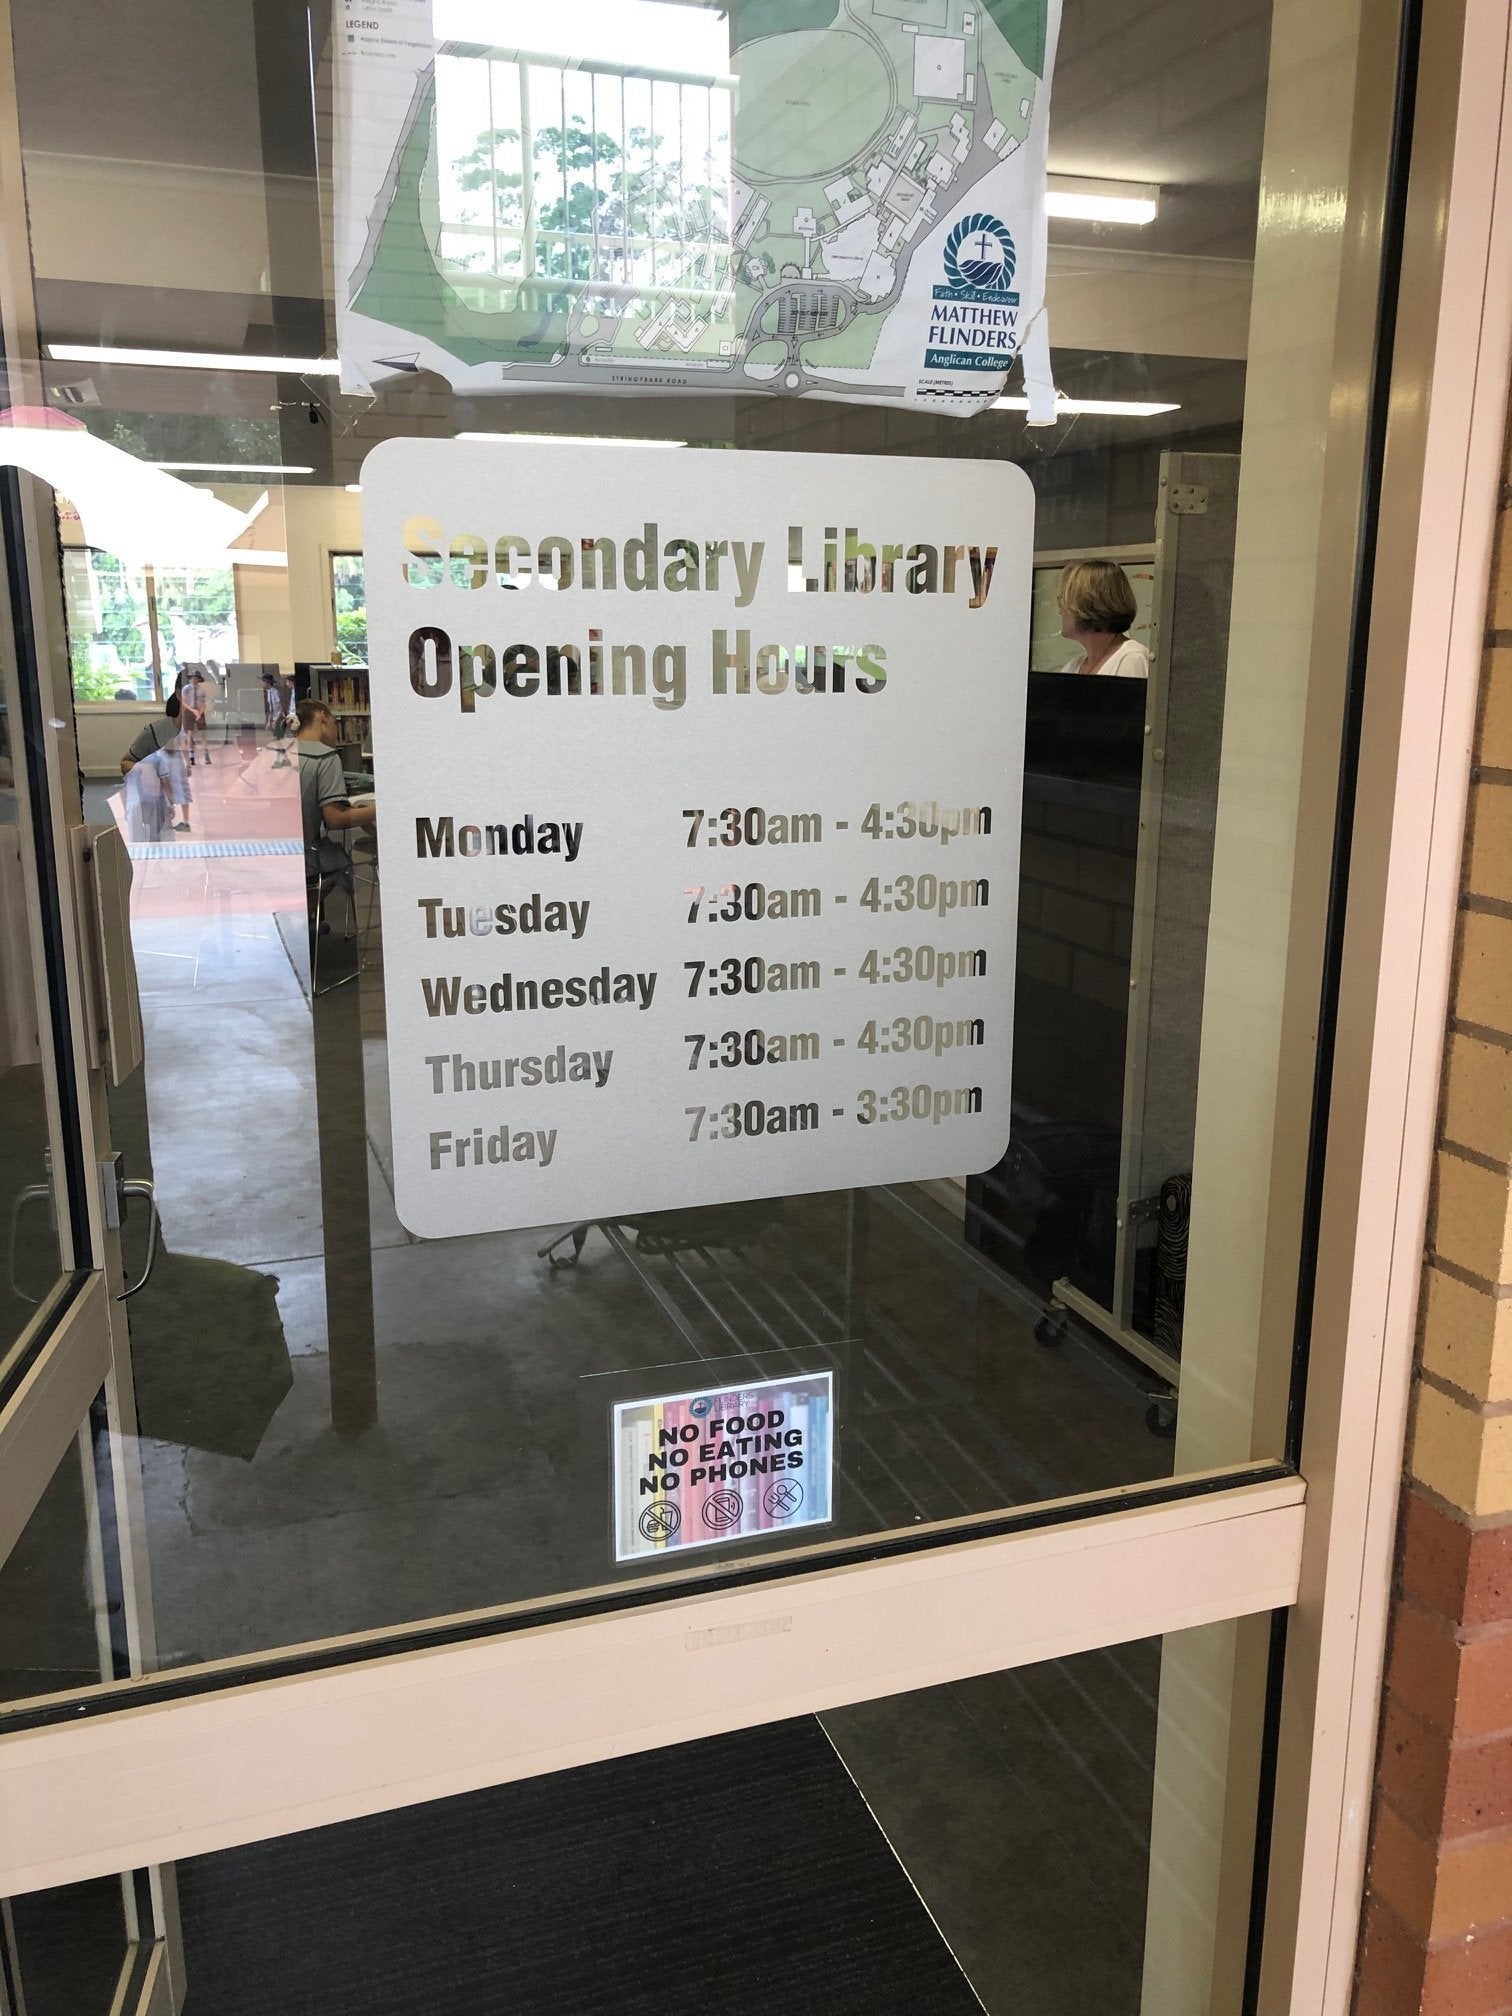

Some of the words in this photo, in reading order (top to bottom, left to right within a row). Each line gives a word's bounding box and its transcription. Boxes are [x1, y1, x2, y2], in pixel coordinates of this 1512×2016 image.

[345, 20, 379, 29] LEGEND
[931, 304, 1019, 327] MATTHEW
[934, 287, 954, 298] Faith
[960, 289, 976, 300] Skill
[928, 325, 1017, 350] FLINDERS
[930, 353, 972, 367] Anglican
[975, 356, 1009, 370] College
[402, 515, 765, 608] Secondary
[788, 526, 999, 609] Library
[408, 626, 687, 713] Opening
[712, 629, 887, 695] Hours
[415, 814, 584, 862] Monday
[682, 806, 822, 848] 7:30am
[861, 801, 992, 846] 4:30pm
[418, 893, 591, 940] Tuesday
[683, 882, 822, 923] 7:30am
[860, 873, 990, 917] 4:30pm
[421, 966, 658, 1018] Wednesday
[684, 956, 821, 998] 7:30am
[858, 945, 987, 988] 4:30pm
[425, 1045, 614, 1094] Thursday
[684, 1029, 820, 1071] 7:30am
[857, 1014, 985, 1057] 4:30pm
[429, 1125, 558, 1171] Friday
[684, 1100, 819, 1142] 7:30am
[857, 1084, 983, 1125] 3:30pm
[648, 1449, 689, 1471] NO
[699, 1429, 803, 1463] EATING
[658, 1424, 700, 1447] NO
[709, 1410, 785, 1439] FOOD
[639, 1472, 680, 1496] NO
[690, 1451, 804, 1487] PHONES
